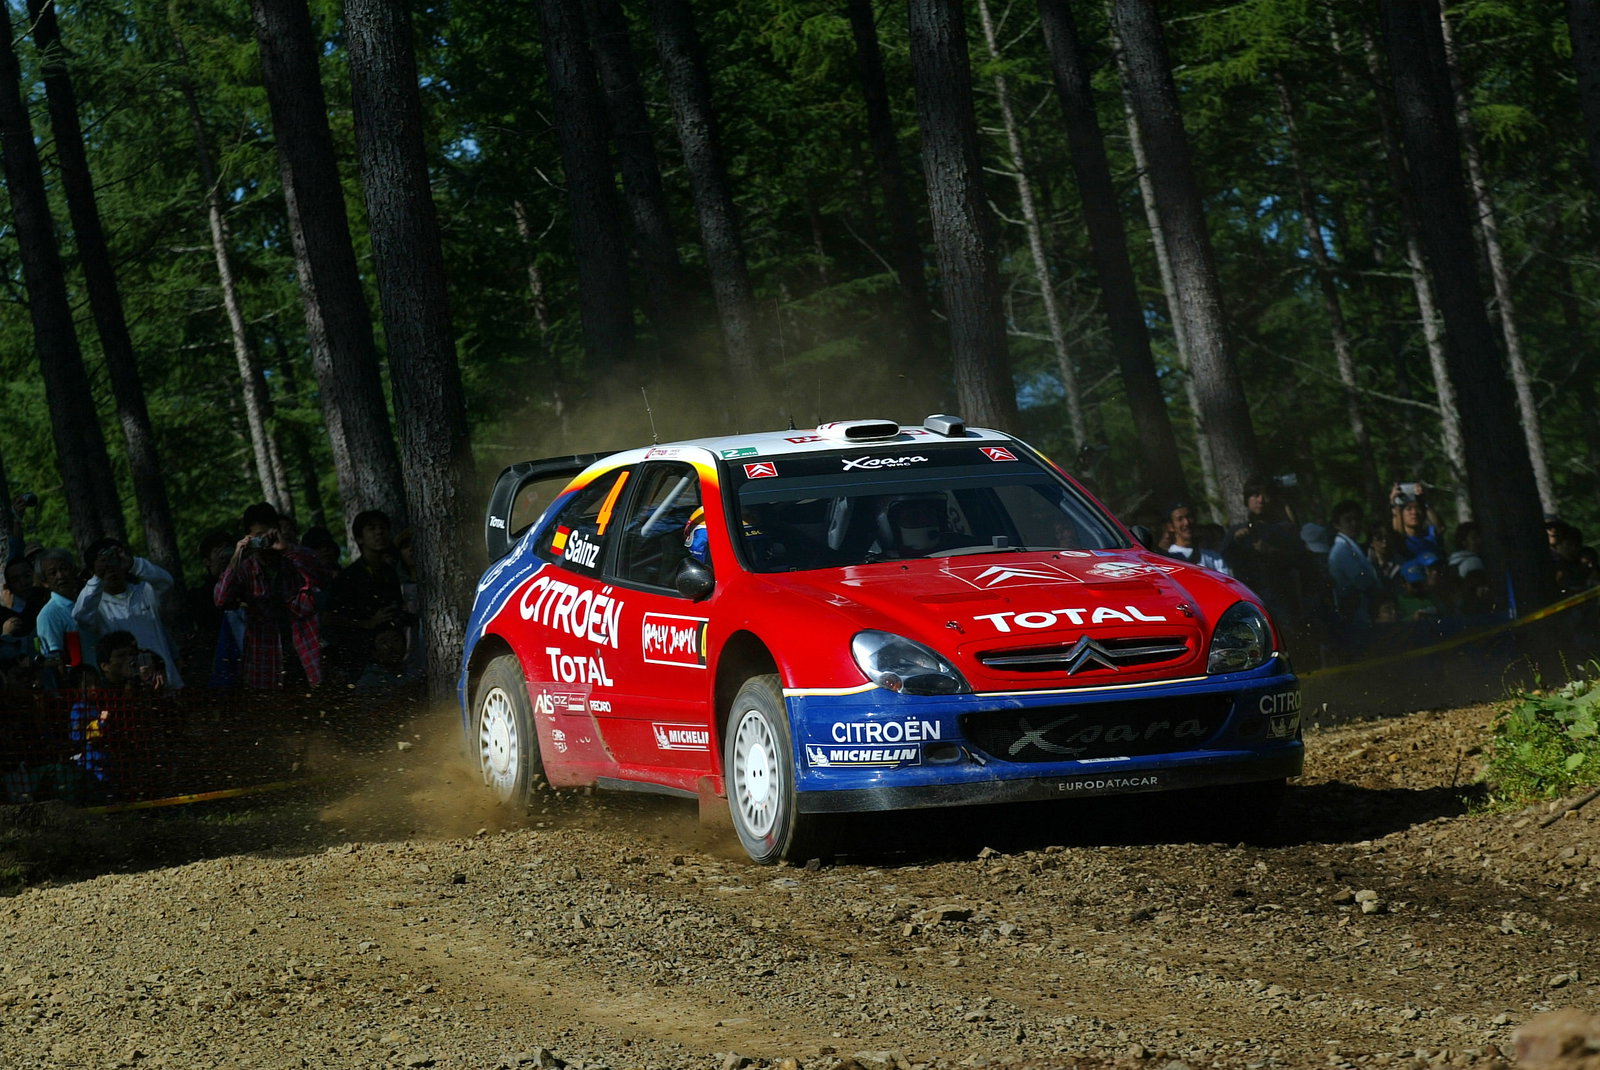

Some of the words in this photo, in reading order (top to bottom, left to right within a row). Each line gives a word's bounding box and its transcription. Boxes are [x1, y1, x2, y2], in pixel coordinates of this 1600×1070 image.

[841, 456, 929, 471] Xsara
[596, 471, 630, 536] 4
[565, 530, 600, 568] Sainz
[520, 575, 625, 649] CITROËN
[973, 606, 1167, 632] TOTAL
[545, 647, 614, 687] TOTAL
[832, 716, 941, 743] CITROËN
[1008, 714, 1207, 755] Xsara
[830, 748, 917, 761] MICHELIN
[1058, 776, 1159, 792] EURODATACAR
